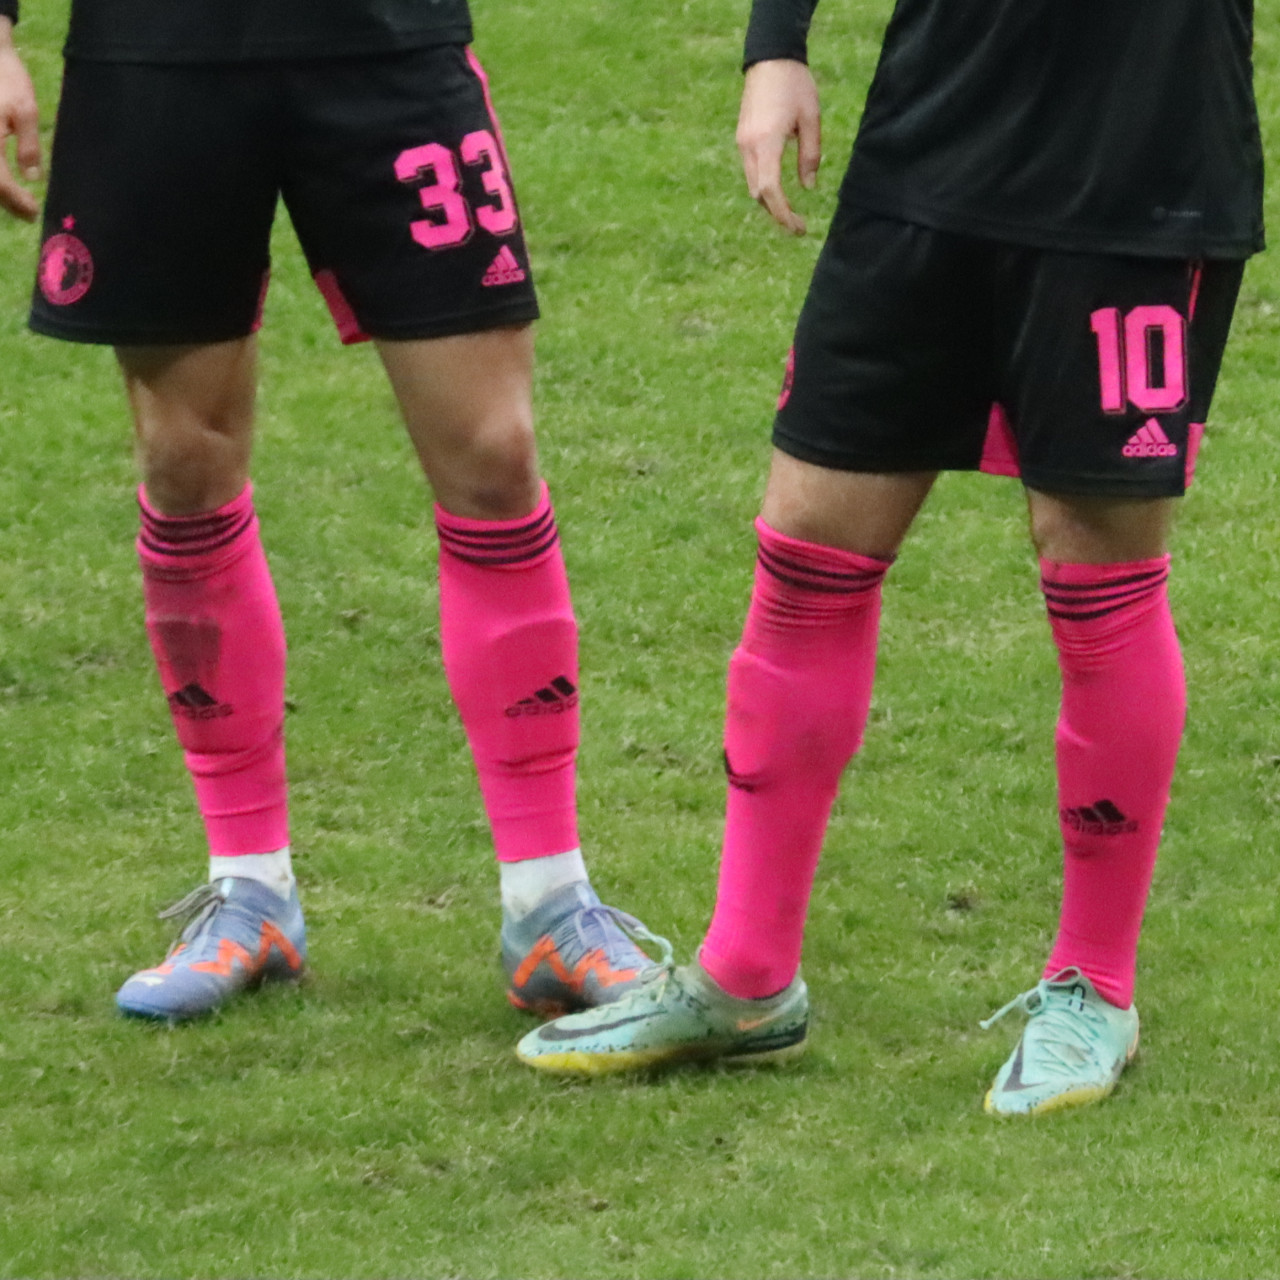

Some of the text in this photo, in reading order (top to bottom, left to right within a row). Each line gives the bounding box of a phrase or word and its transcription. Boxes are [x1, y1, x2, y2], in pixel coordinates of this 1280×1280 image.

[393, 129, 518, 250] 33
[1090, 305, 1190, 414] 10
[1122, 443, 1178, 458] adidas
